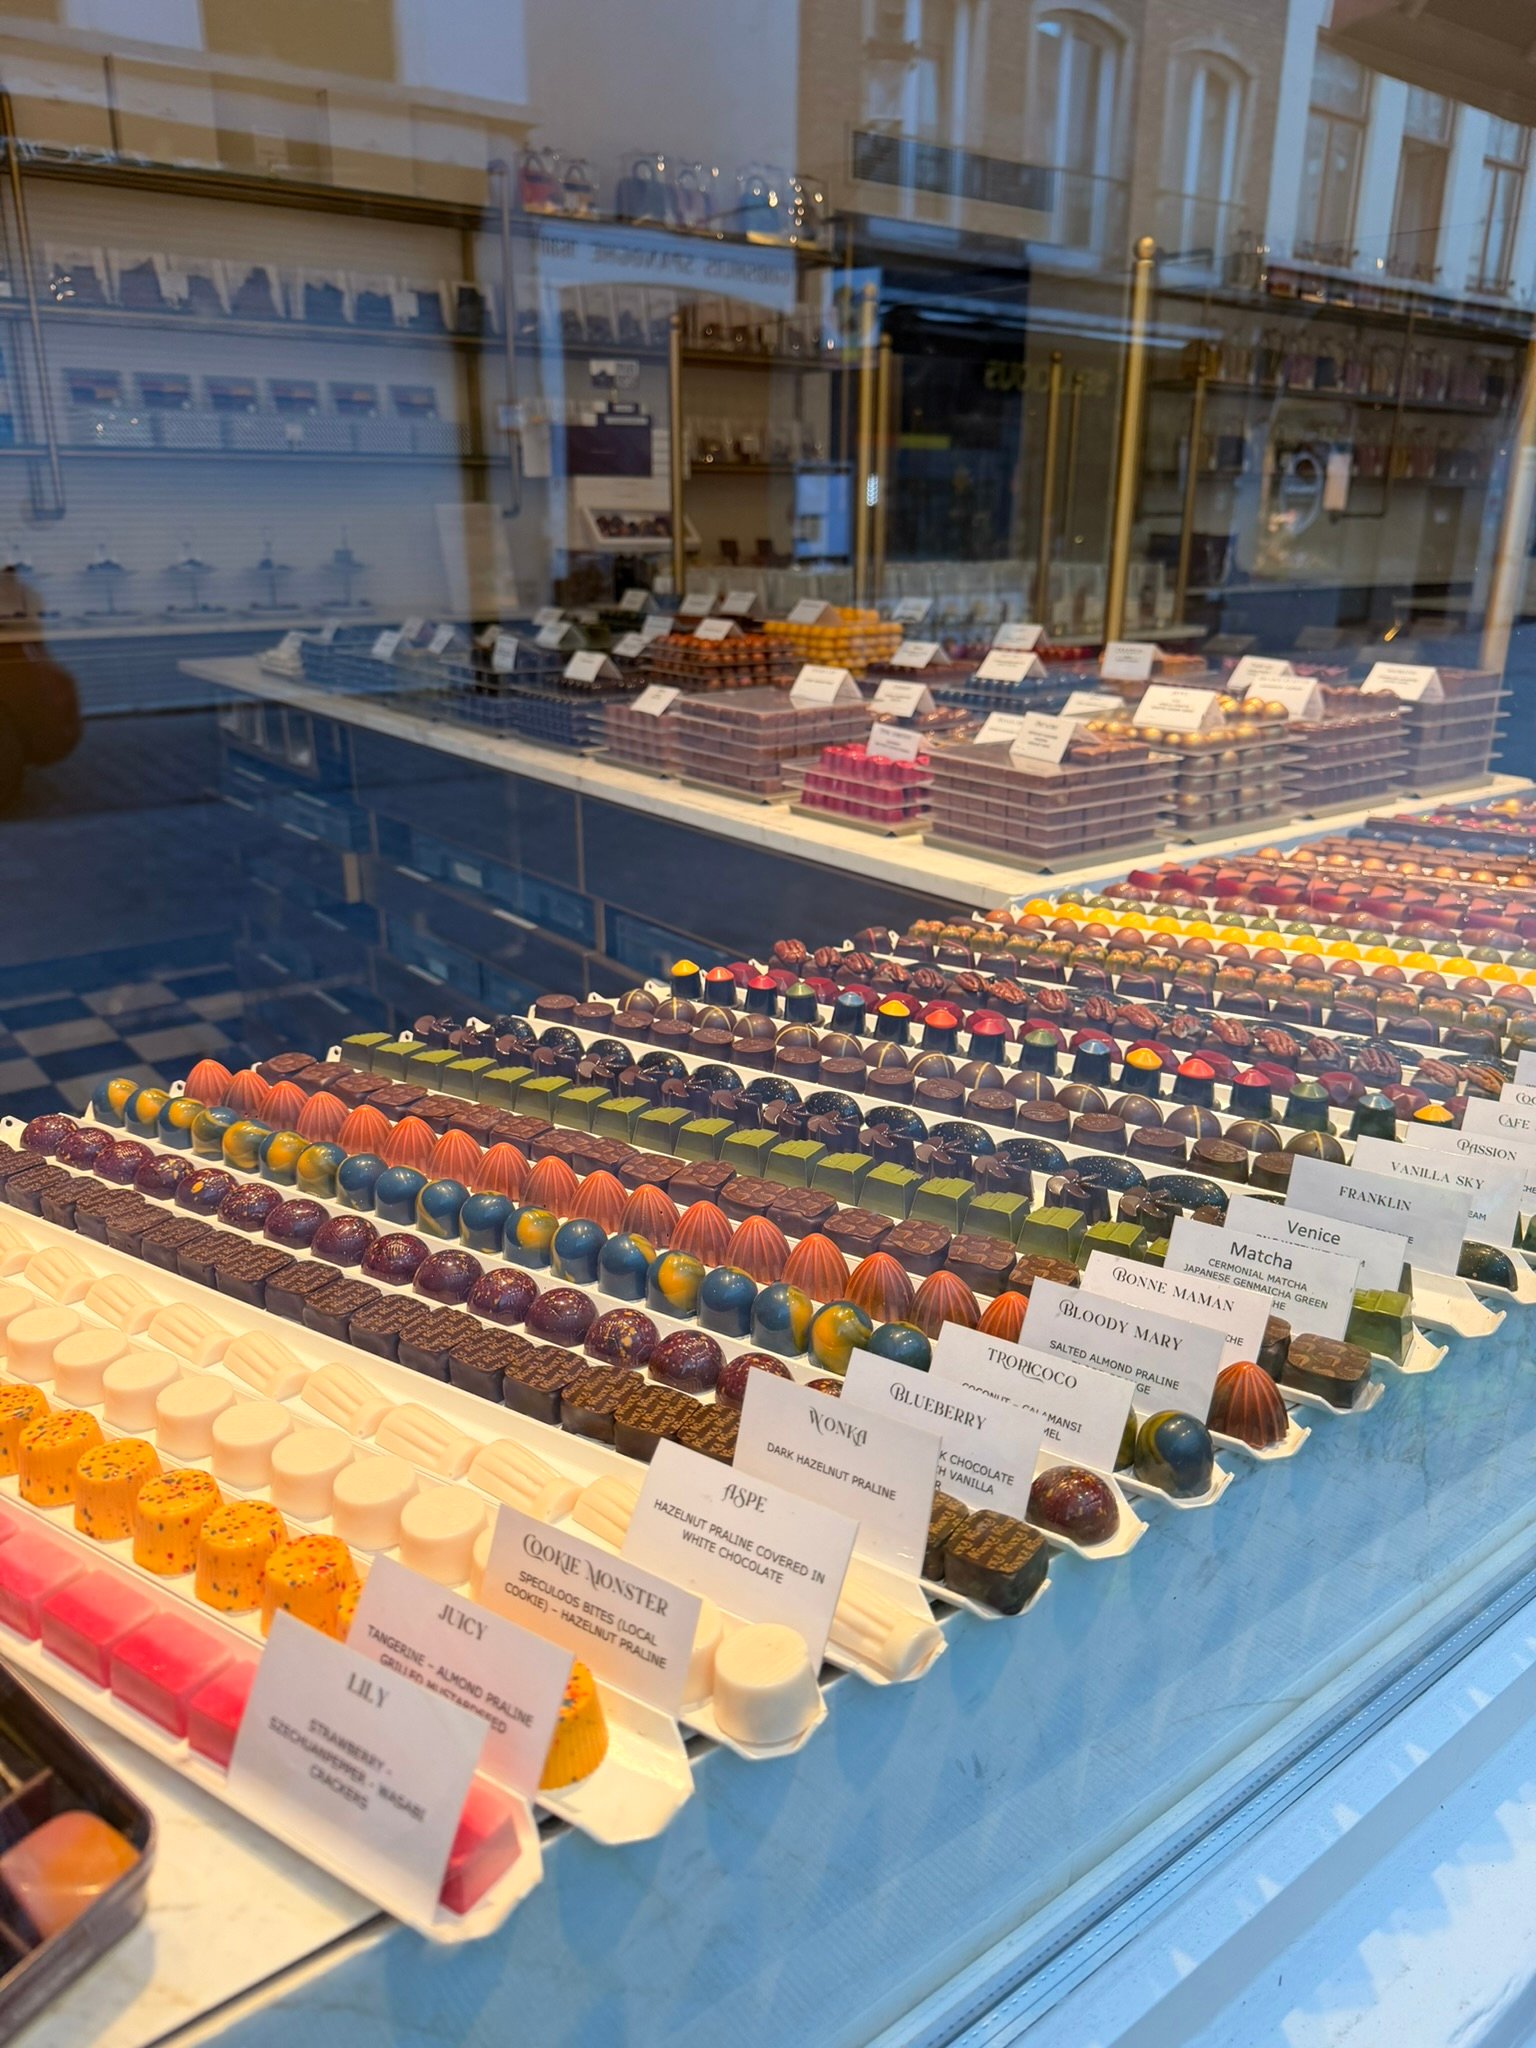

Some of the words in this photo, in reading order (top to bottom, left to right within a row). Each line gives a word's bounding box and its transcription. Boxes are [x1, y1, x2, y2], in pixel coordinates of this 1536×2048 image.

[1456, 1138, 1518, 1161] PASSION
[1391, 1161, 1450, 1183] VANILLA
[1456, 1175, 1485, 1190] SKY
[1339, 1185, 1412, 1211] FRANKLIN
[1287, 1219, 1341, 1245] Venice
[1208, 1258, 1264, 1281] CERMONIAL
[1267, 1274, 1307, 1292] MATCHA
[1230, 1241, 1293, 1270] Matcha
[1112, 1266, 1168, 1295] BONNE
[1172, 1285, 1235, 1312] MAMAN
[1183, 1263, 1230, 1283] JAPANESE
[1233, 1277, 1291, 1300] GENMAICHA
[1295, 1293, 1328, 1310] GREEN
[1058, 1299, 1129, 1334] BLOODY
[1133, 1325, 1183, 1351] MARY
[988, 1347, 1078, 1389] TROPICOCO
[1049, 1340, 1087, 1359] SALTED
[1089, 1353, 1133, 1374] ALMOND
[1135, 1368, 1180, 1390] PRALINE
[808, 1405, 868, 1448] WONKA
[889, 1382, 987, 1430] BLUEBERRY
[766, 1442, 795, 1460] DARK
[796, 1453, 850, 1481] HAZELNUT
[851, 1475, 897, 1501] PRALINE
[950, 1454, 1015, 1486] CHOCOLATE
[950, 1469, 994, 1495] VANILLA
[721, 1483, 768, 1513] ASPE
[654, 1499, 708, 1530] HAZELNUT
[709, 1523, 754, 1552] PRALINE
[756, 1545, 809, 1577] COVERED
[810, 1570, 826, 1585] IN
[682, 1529, 717, 1554] WHITE
[718, 1546, 784, 1584] CHOCOLATE
[523, 1533, 581, 1576] COOKIE
[584, 1559, 669, 1617] MONSTER
[438, 1604, 488, 1640] JUICY
[504, 1582, 549, 1613] COOKIE)
[561, 1609, 617, 1644] HAZELNUT
[619, 1637, 667, 1670] PRALINE
[519, 1570, 581, 1608] SPECULOOS
[582, 1602, 615, 1625] BITES
[617, 1618, 657, 1647] (LOCAL
[346, 1672, 390, 1708] LILY
[367, 1624, 426, 1667] TANGERINE
[436, 1665, 483, 1699] ALMOND
[486, 1692, 534, 1728] PRALINE
[308, 1718, 385, 1771] STRAWBERRY
[309, 1764, 368, 1811] CRACKERS
[378, 1785, 426, 1823] WASABI
